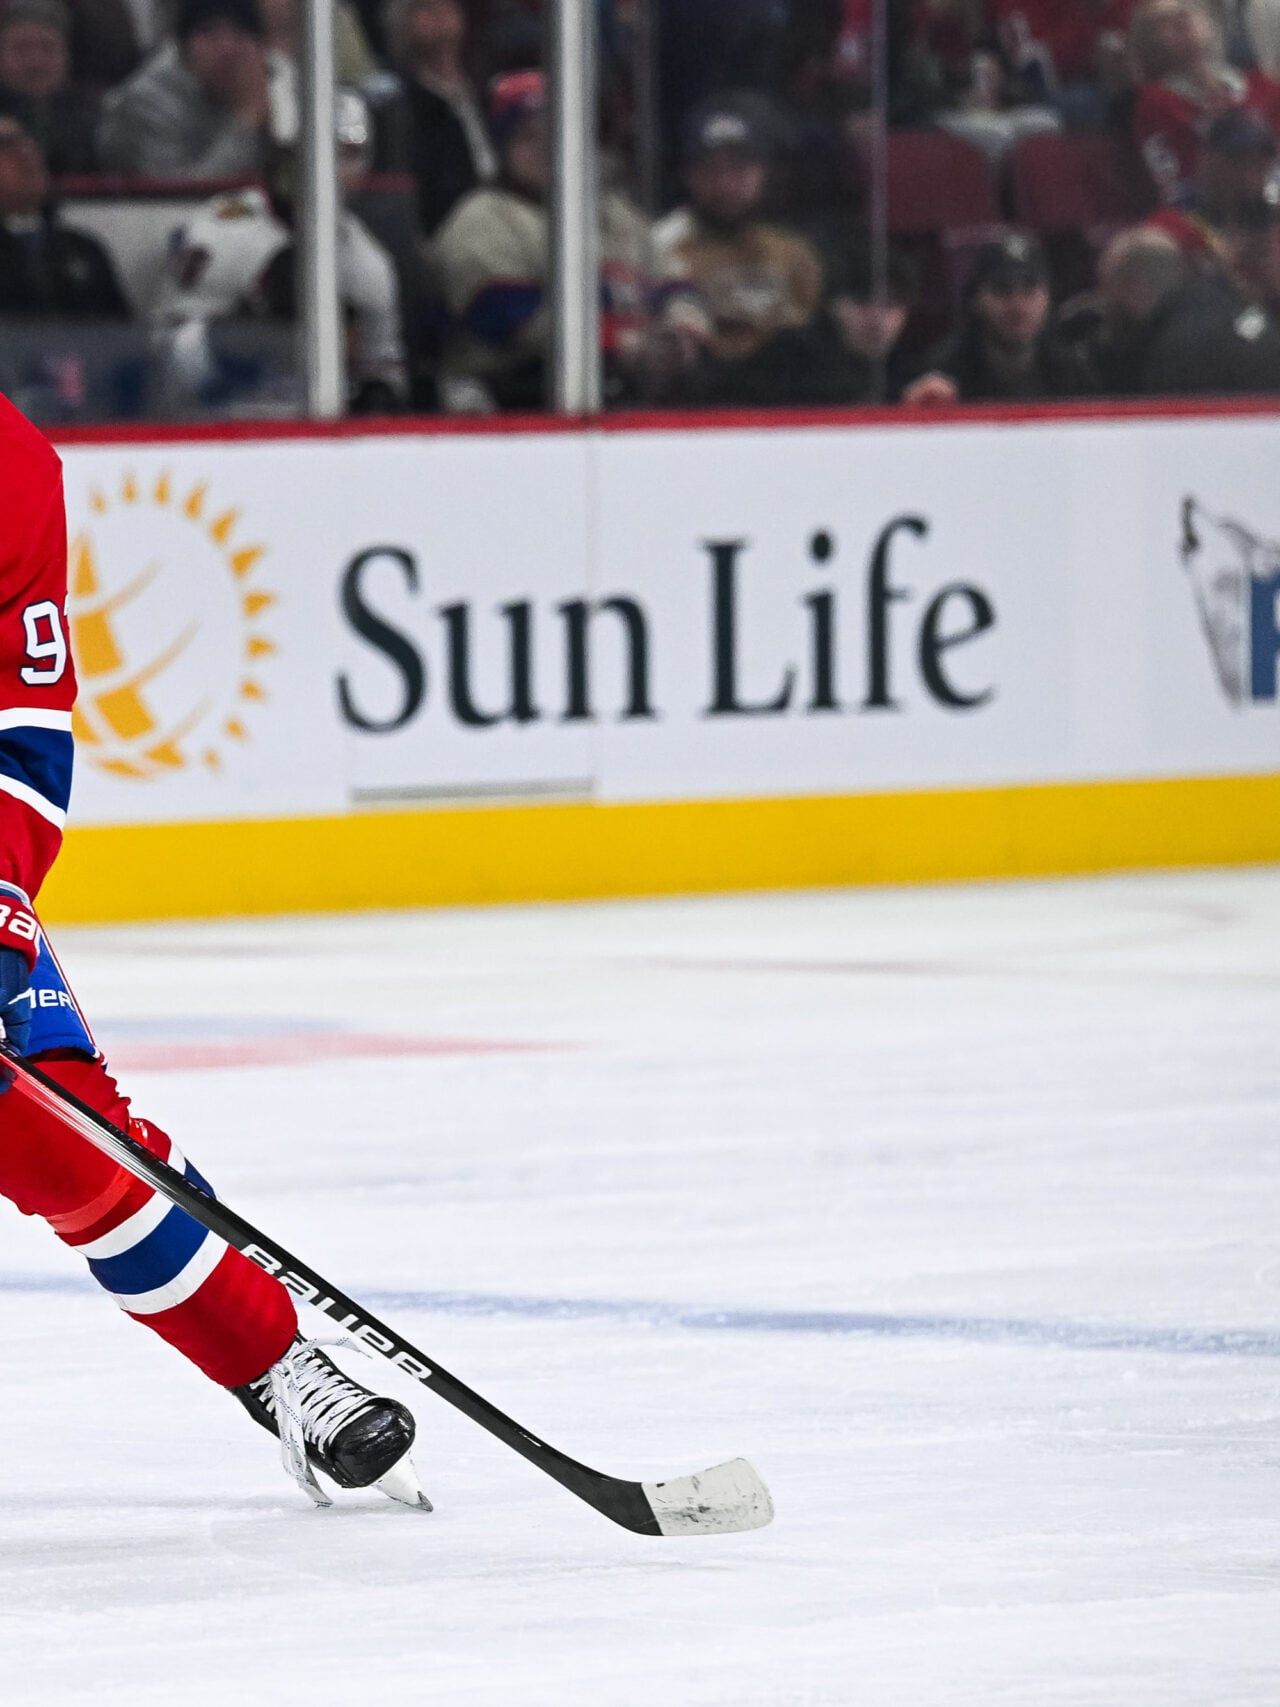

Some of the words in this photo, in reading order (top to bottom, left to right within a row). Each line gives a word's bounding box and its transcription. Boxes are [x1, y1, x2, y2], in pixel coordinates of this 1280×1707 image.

[20, 592, 69, 685] 9
[336, 545, 656, 735] Sun
[699, 512, 996, 717] Life
